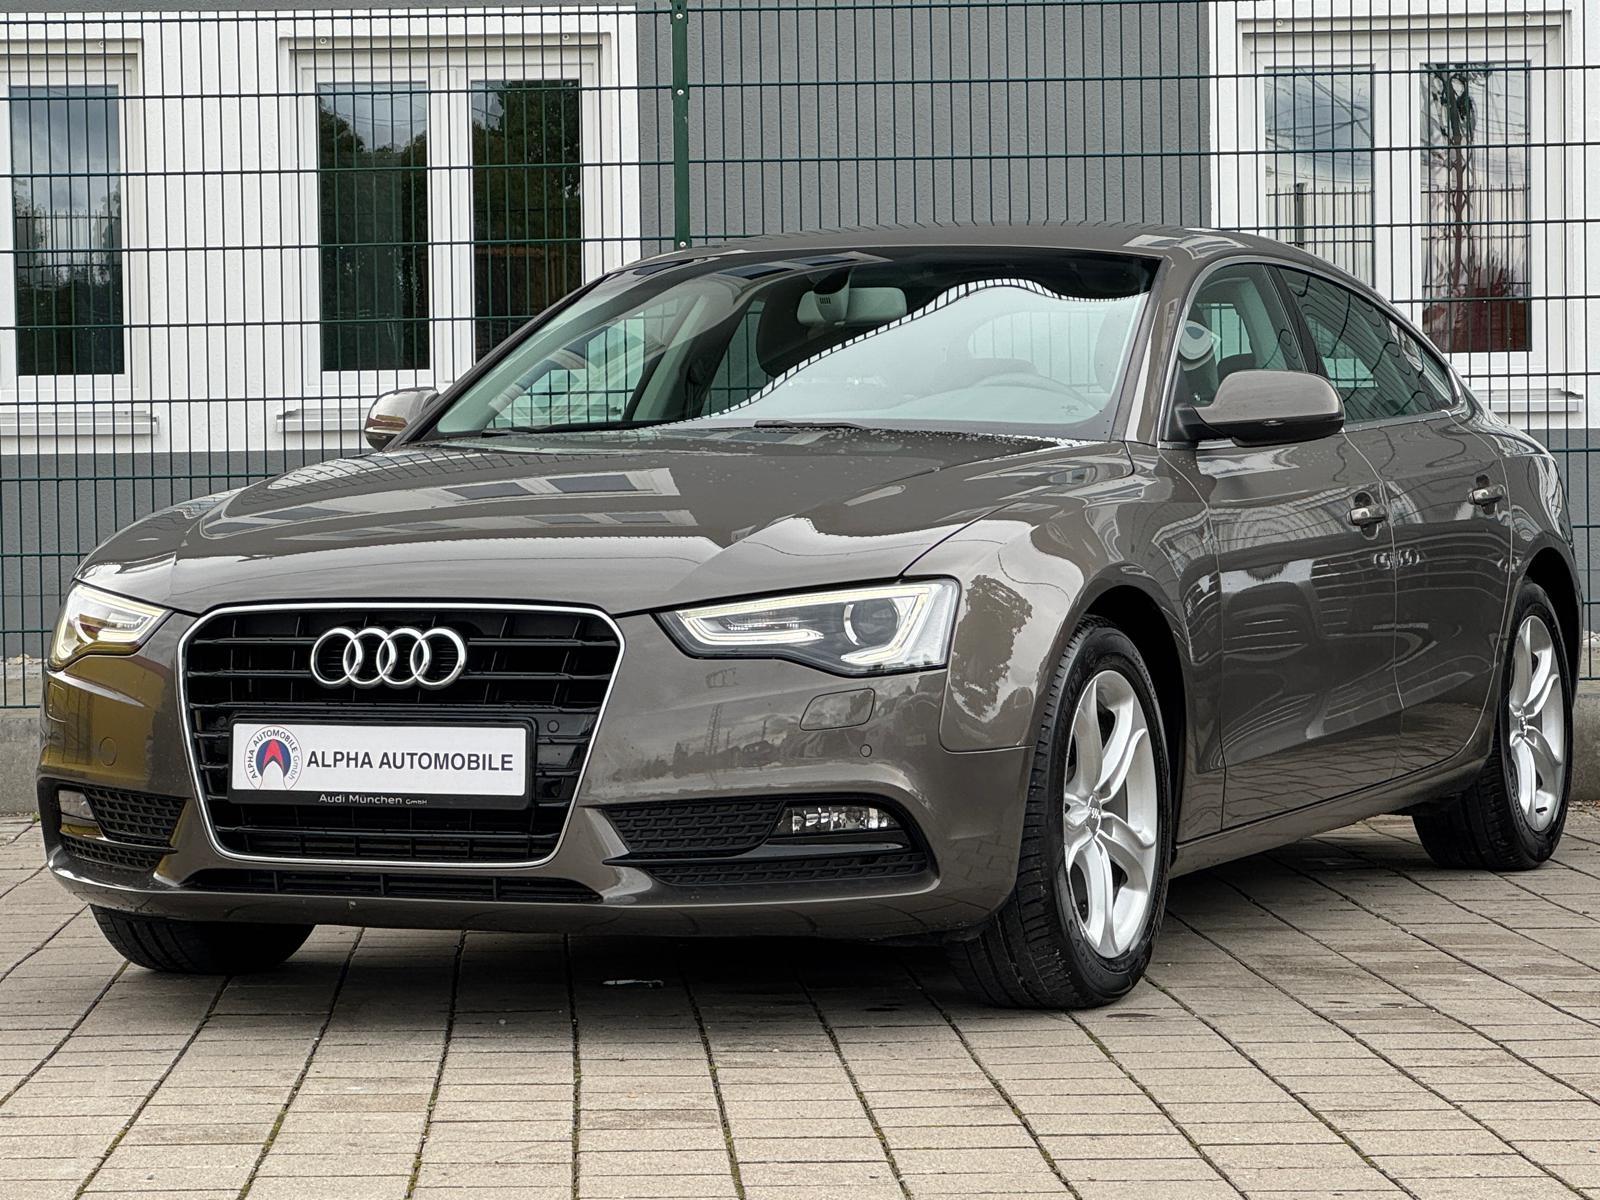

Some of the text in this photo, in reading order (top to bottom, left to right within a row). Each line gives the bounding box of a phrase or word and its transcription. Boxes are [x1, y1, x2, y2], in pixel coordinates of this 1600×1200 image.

[247, 749, 258, 779] ALPHA
[253, 729, 299, 753] AUTOMOBILE
[306, 750, 514, 772] ALPHA AUTOMOBILE
[319, 793, 346, 803] Audi
[348, 794, 403, 805] München
